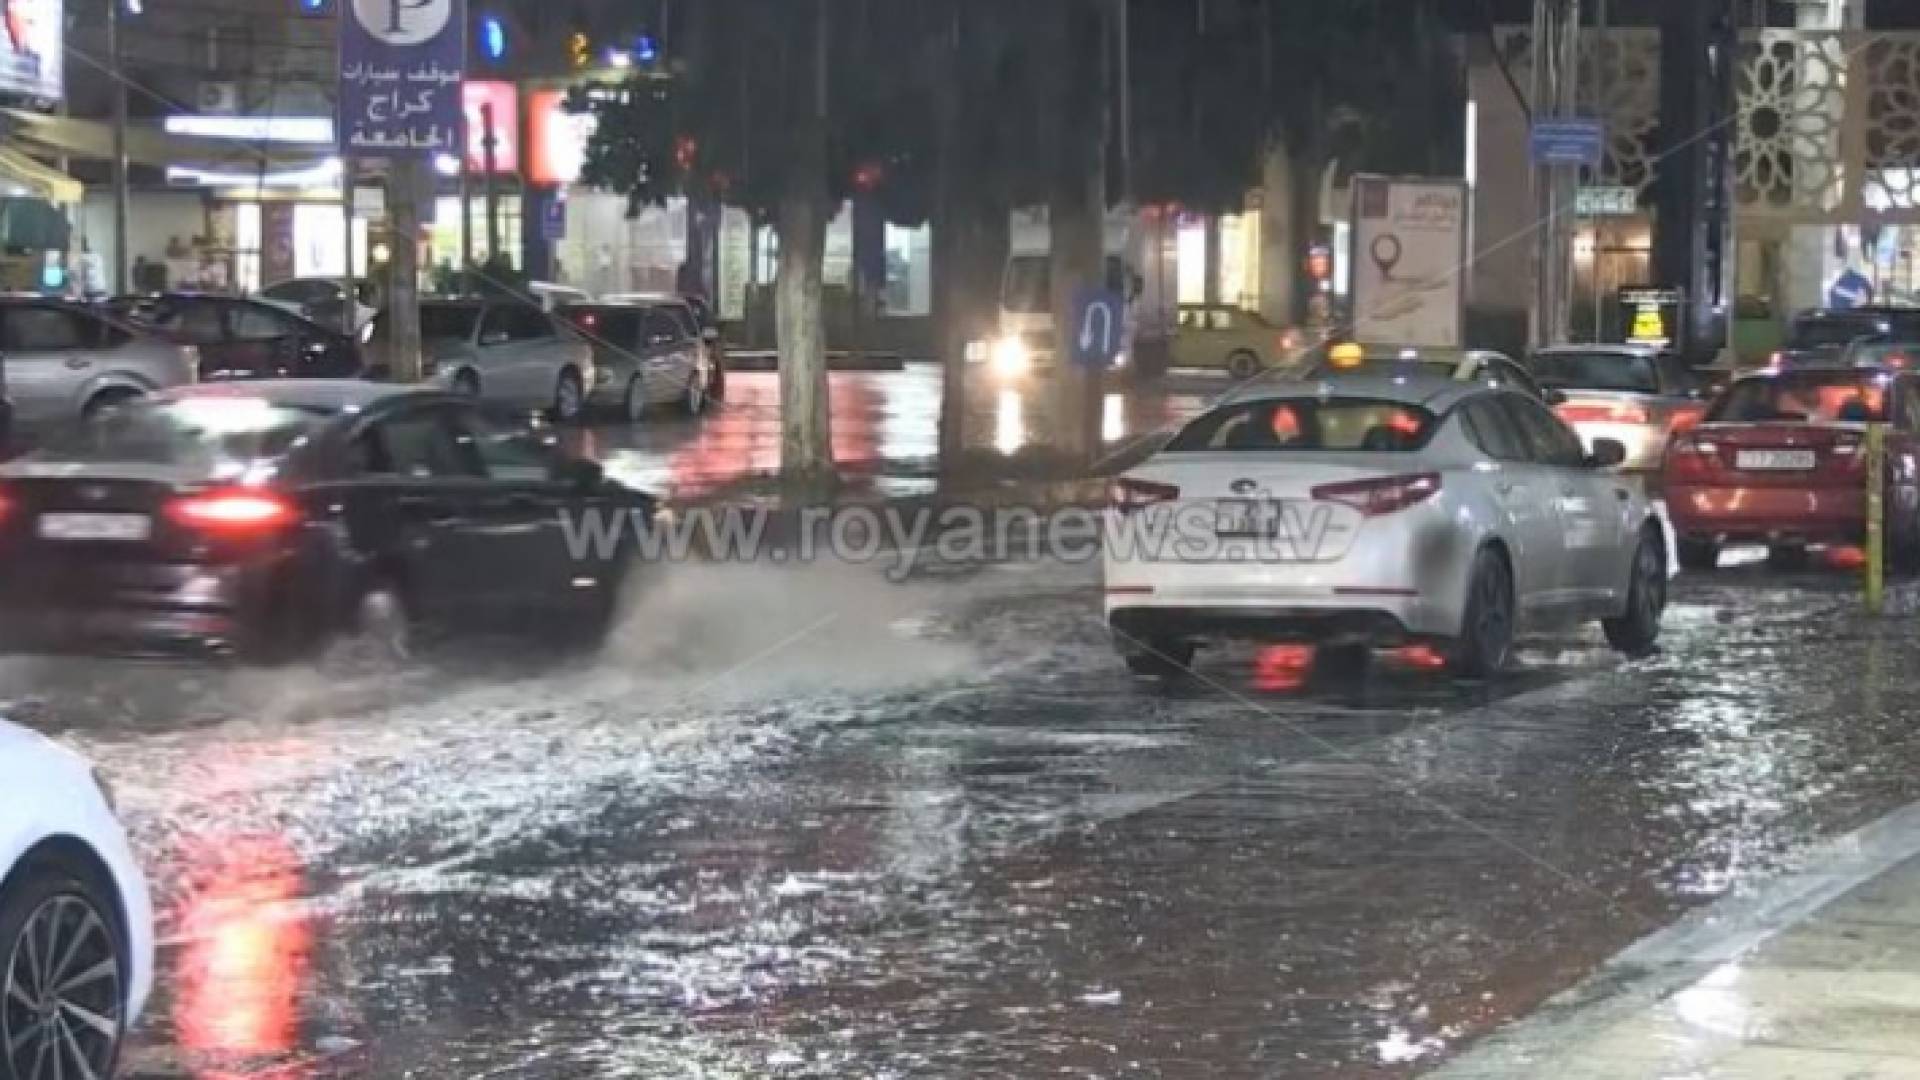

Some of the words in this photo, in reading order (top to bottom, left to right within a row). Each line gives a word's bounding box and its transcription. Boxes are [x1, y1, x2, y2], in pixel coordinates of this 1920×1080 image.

[383, 0, 436, 33] P
[342, 61, 399, 87] سيارات
[406, 61, 460, 87] موقف
[367, 87, 434, 121] كراج
[350, 120, 453, 148] الجامعة
